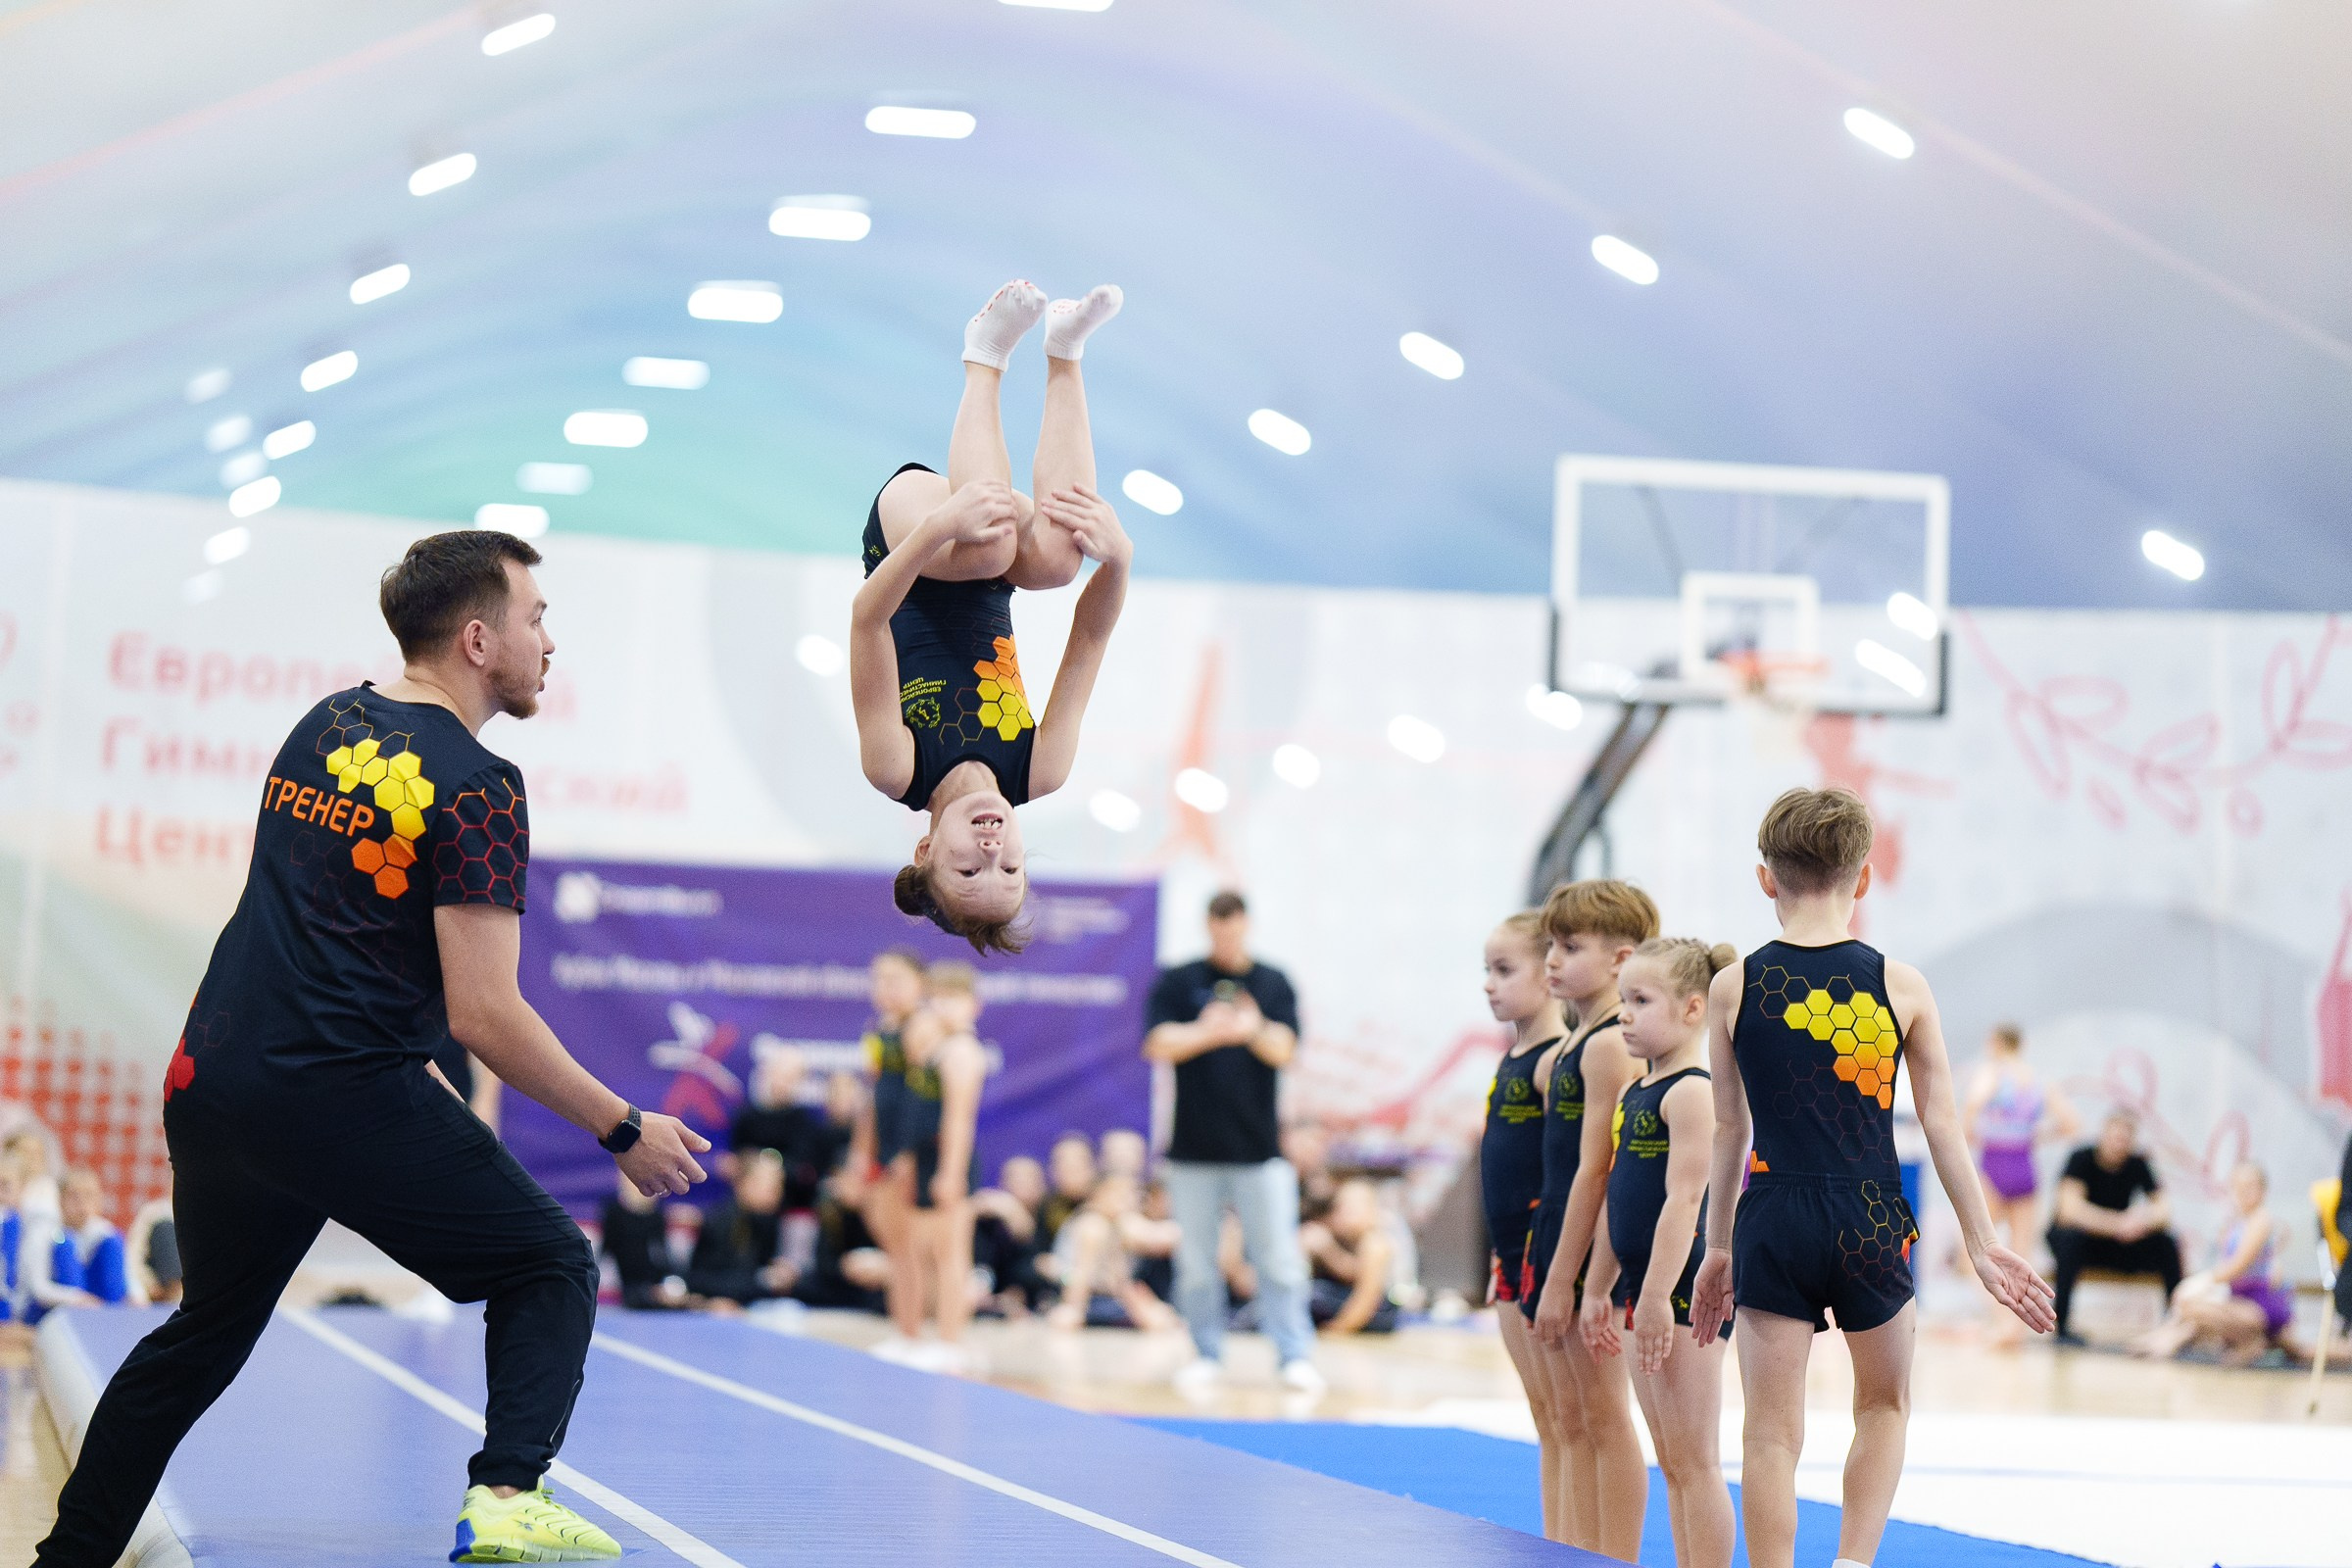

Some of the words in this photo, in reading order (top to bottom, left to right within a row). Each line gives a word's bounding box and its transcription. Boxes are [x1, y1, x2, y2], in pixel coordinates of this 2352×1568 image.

[900, 680, 947, 697] ГИМНАСТИЧЕС
[903, 677, 923, 689] ЦЕНТР
[264, 776, 375, 837] ТРЕНЕР
